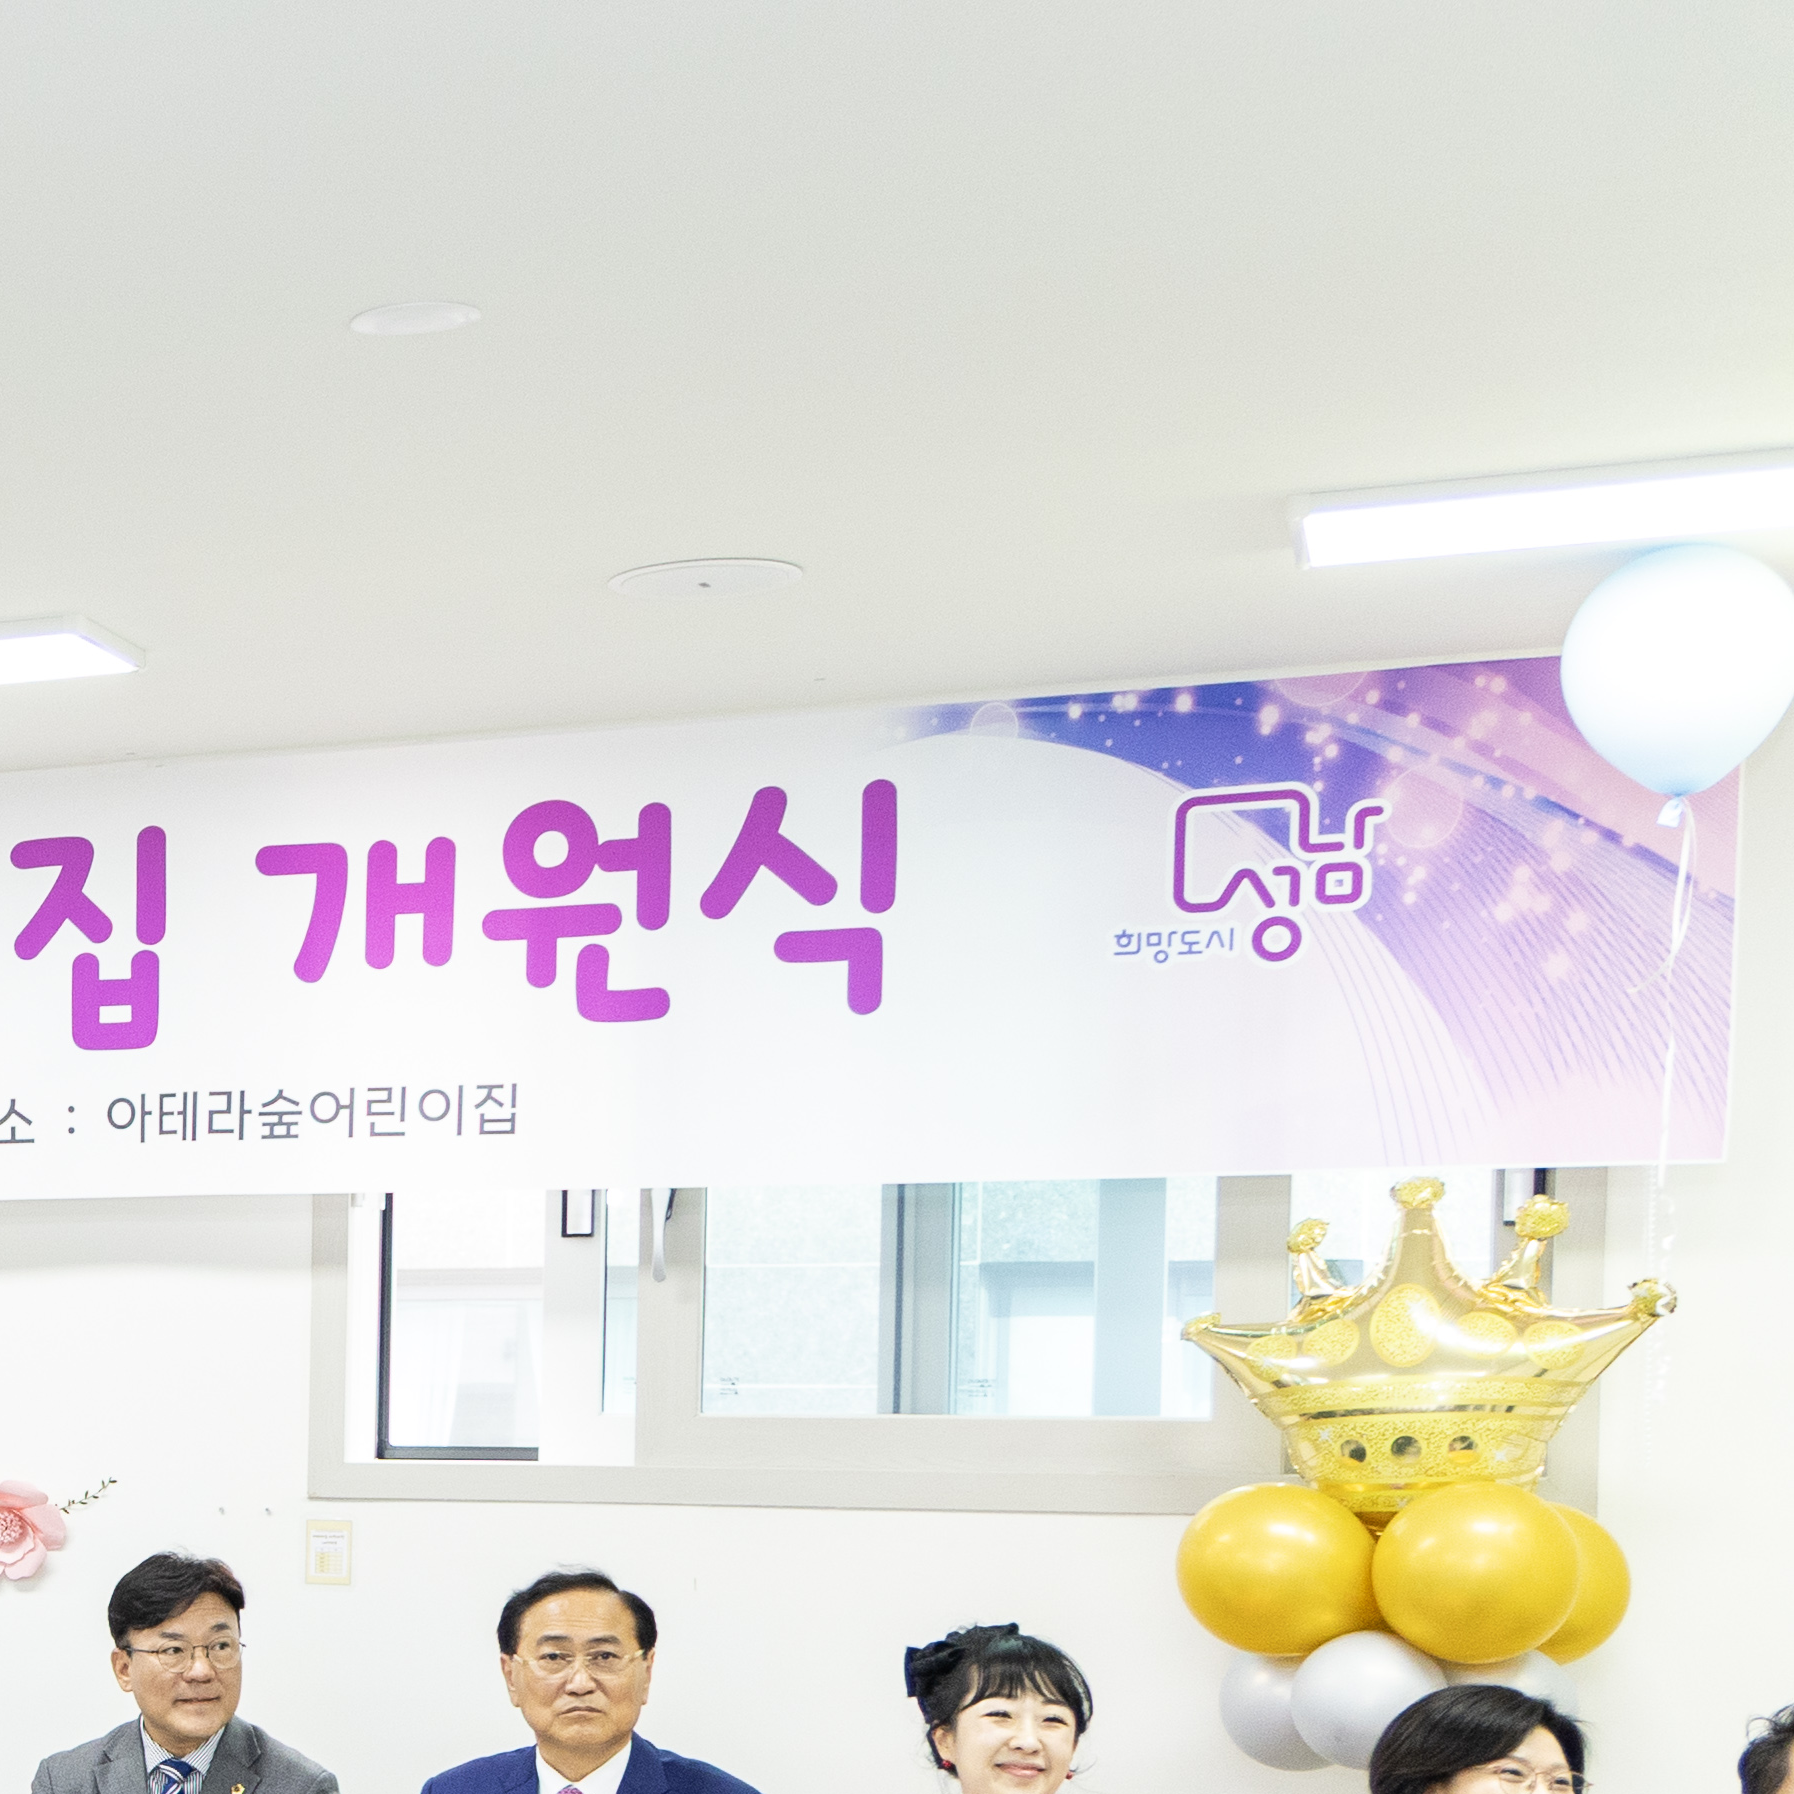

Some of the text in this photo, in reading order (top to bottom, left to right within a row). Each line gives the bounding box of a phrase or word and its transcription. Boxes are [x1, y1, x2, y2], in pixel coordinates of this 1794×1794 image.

[254, 778, 898, 1024] 개원식
[1112, 927, 1235, 965] 희망도시
[105, 1081, 519, 1145] 아테라숲어린이집
